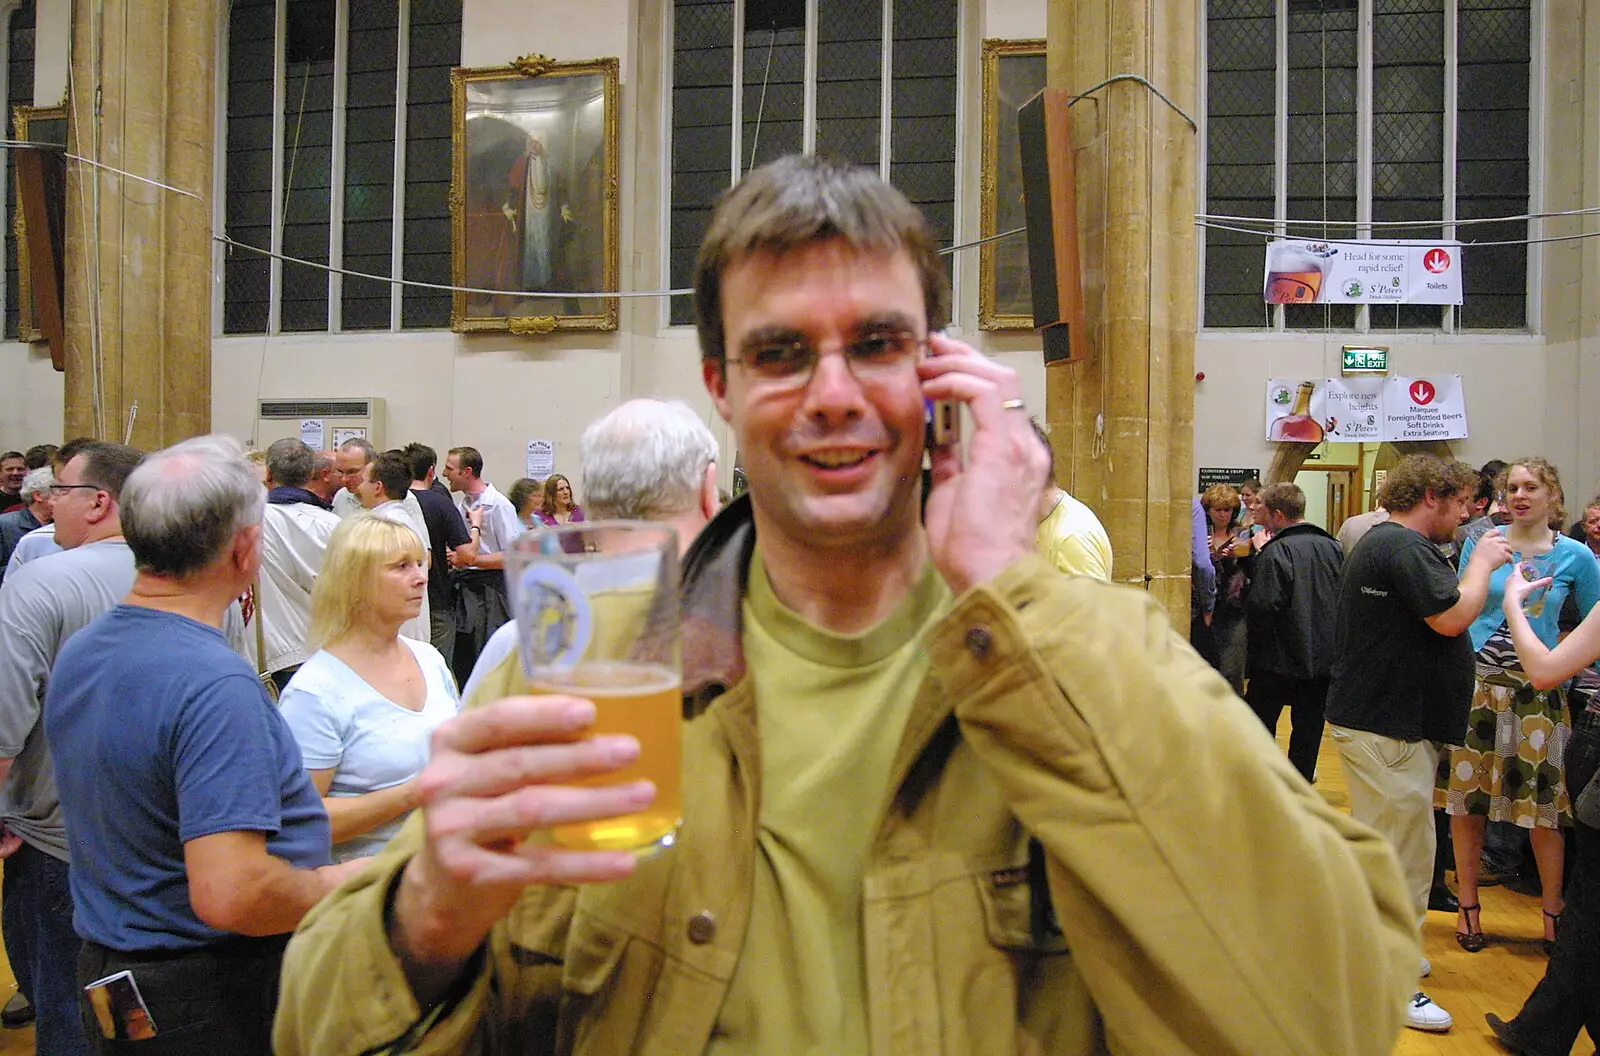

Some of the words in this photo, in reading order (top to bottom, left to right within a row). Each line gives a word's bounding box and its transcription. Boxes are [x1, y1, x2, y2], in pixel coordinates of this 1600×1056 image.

[1344, 252, 1367, 261] Head
[1368, 252, 1380, 261] for
[1358, 263, 1379, 274] rapid
[1426, 282, 1448, 290] Toilets
[1367, 353, 1385, 361] FIRE
[1328, 390, 1360, 402] Explore
[1349, 402, 1378, 412] heights
[1409, 406, 1439, 414] Marquee
[1387, 414, 1441, 422] Foreign/Bottled
